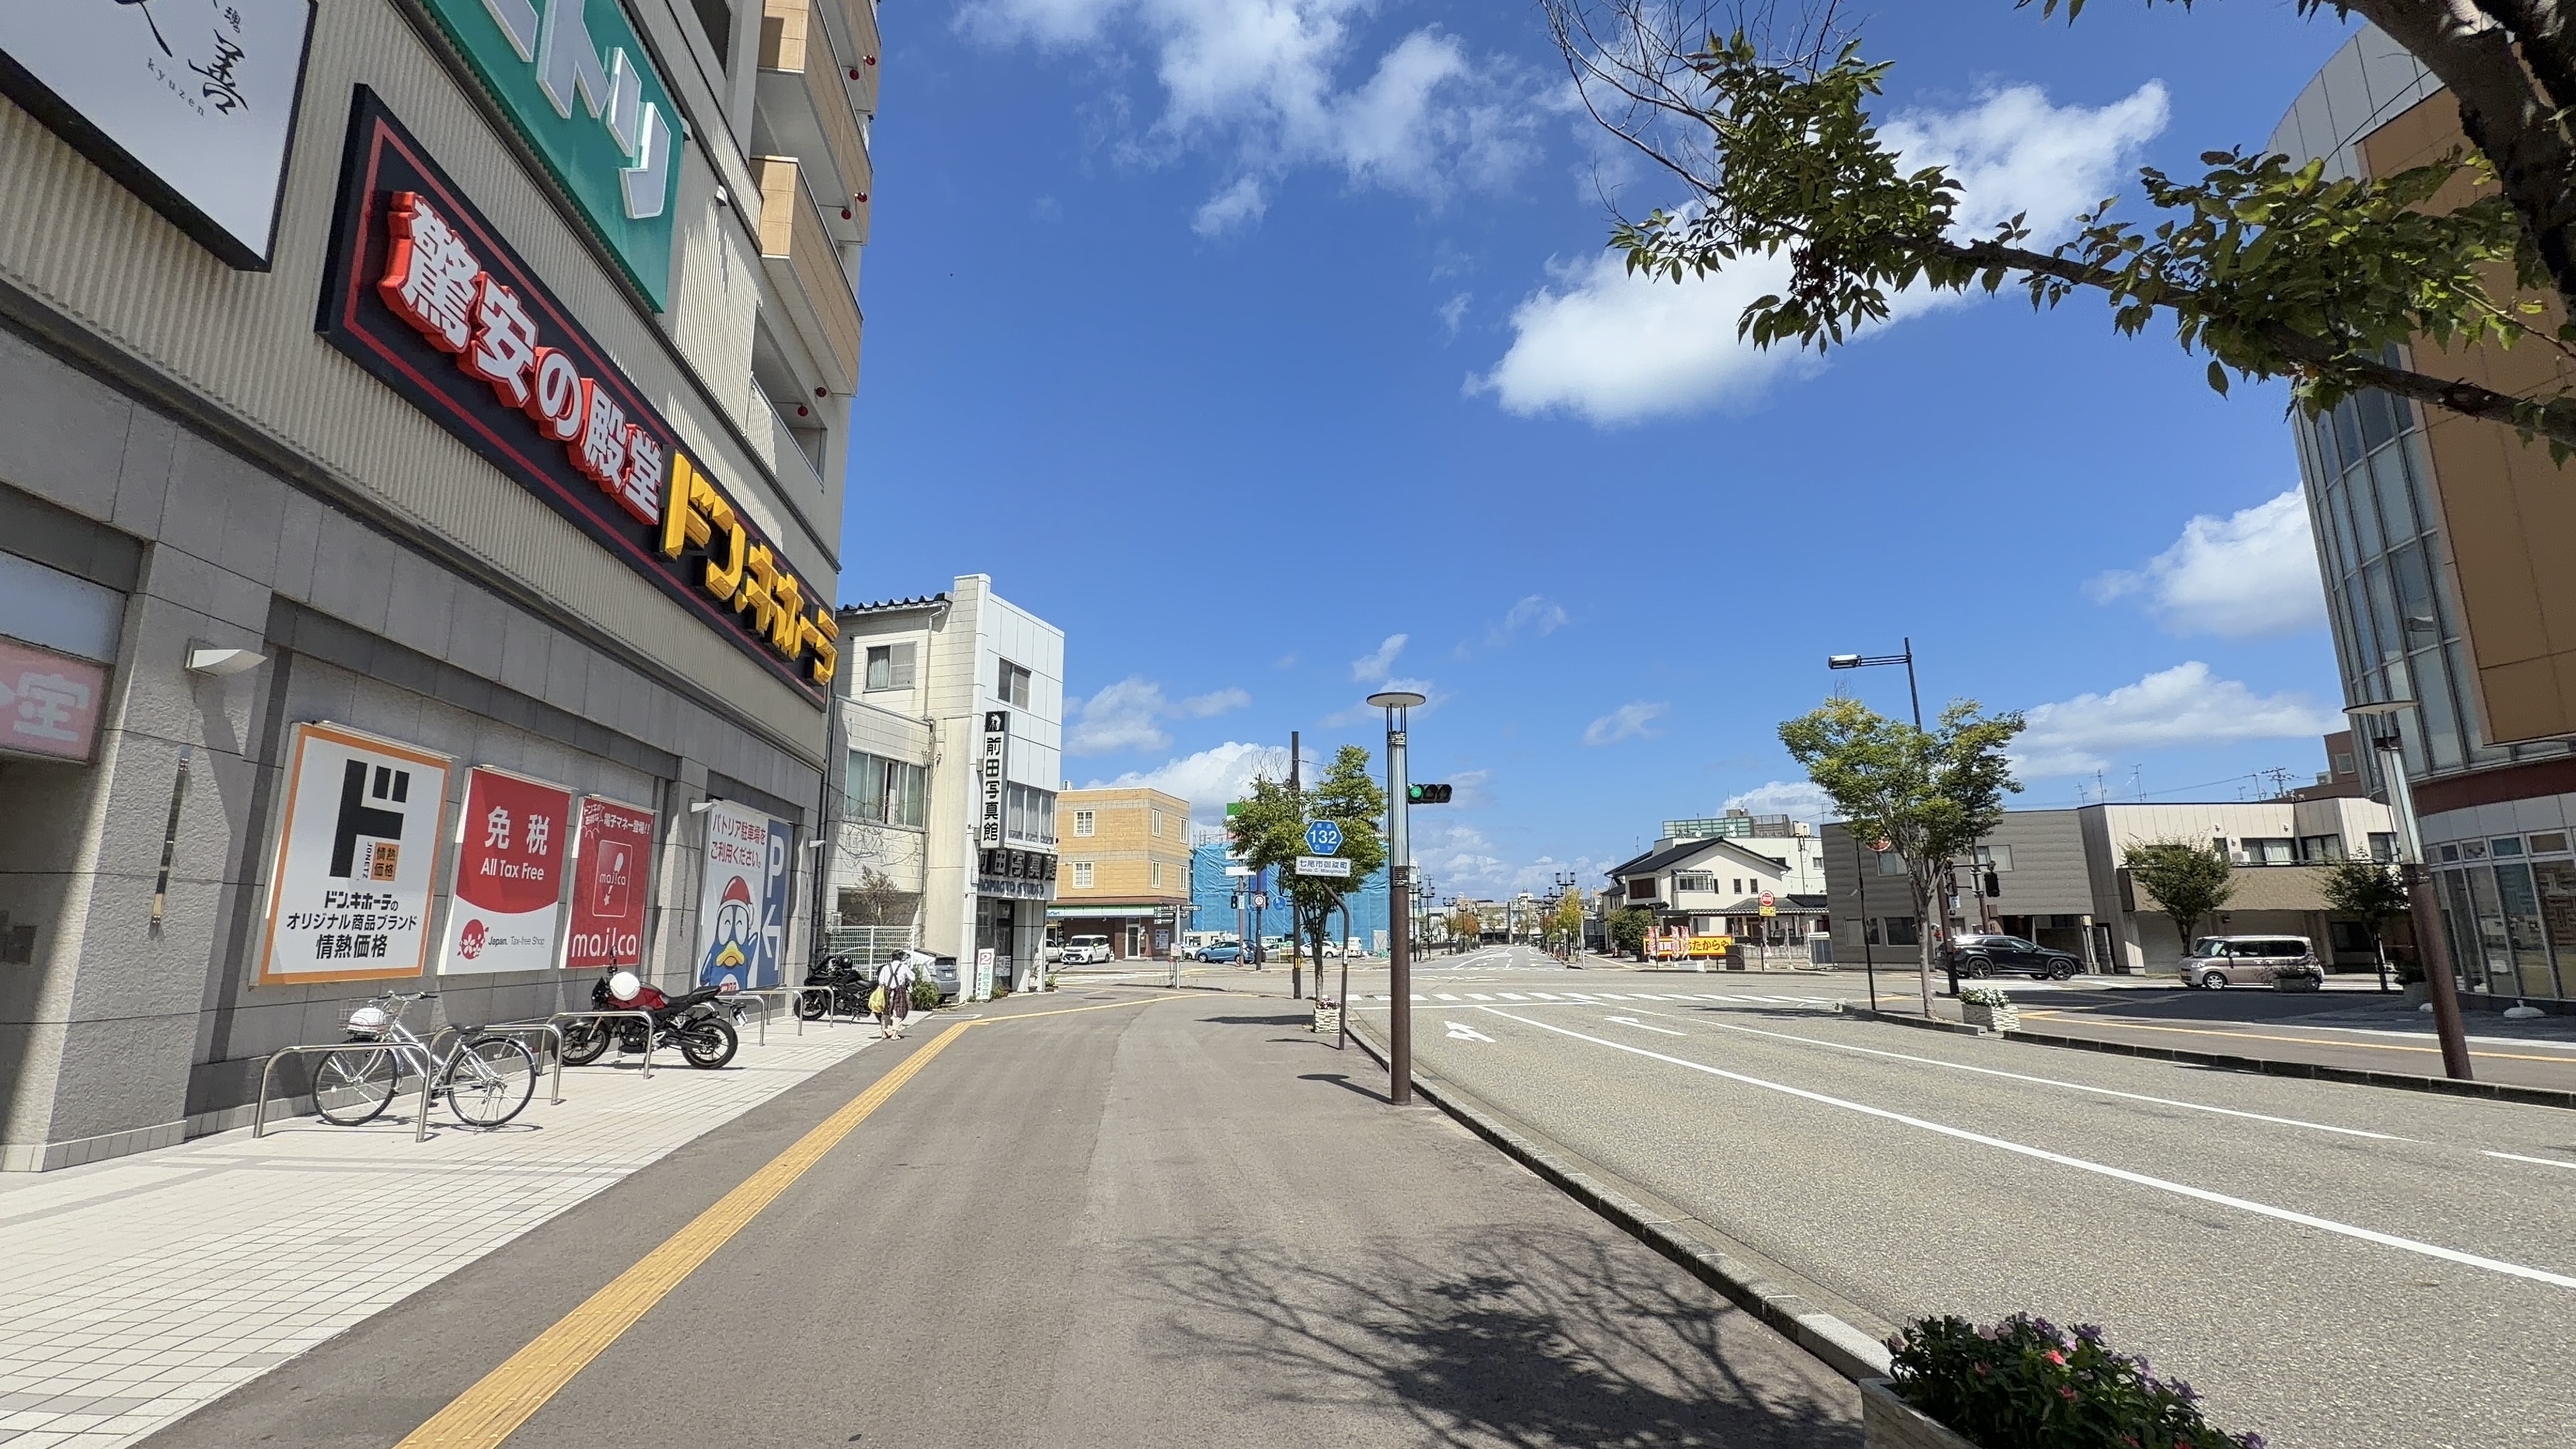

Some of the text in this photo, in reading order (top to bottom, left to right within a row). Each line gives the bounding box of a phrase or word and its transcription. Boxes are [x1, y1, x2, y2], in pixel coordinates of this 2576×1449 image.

[147, 58, 205, 116] kyuzen
[392, 193, 663, 525] 驚安の殿堂
[983, 737, 1001, 841] 前田写真館
[484, 806, 550, 855] 免税
[712, 814, 765, 845] パトリア駐車場を
[1310, 830, 1337, 844] 132
[362, 841, 373, 879] JONETZ
[480, 858, 544, 881] All Tax Free
[766, 835, 784, 898] P
[286, 912, 417, 930] オリジナル商品ブランド
[316, 934, 388, 959] 情熱価格
[531, 936, 545, 948] Shop
